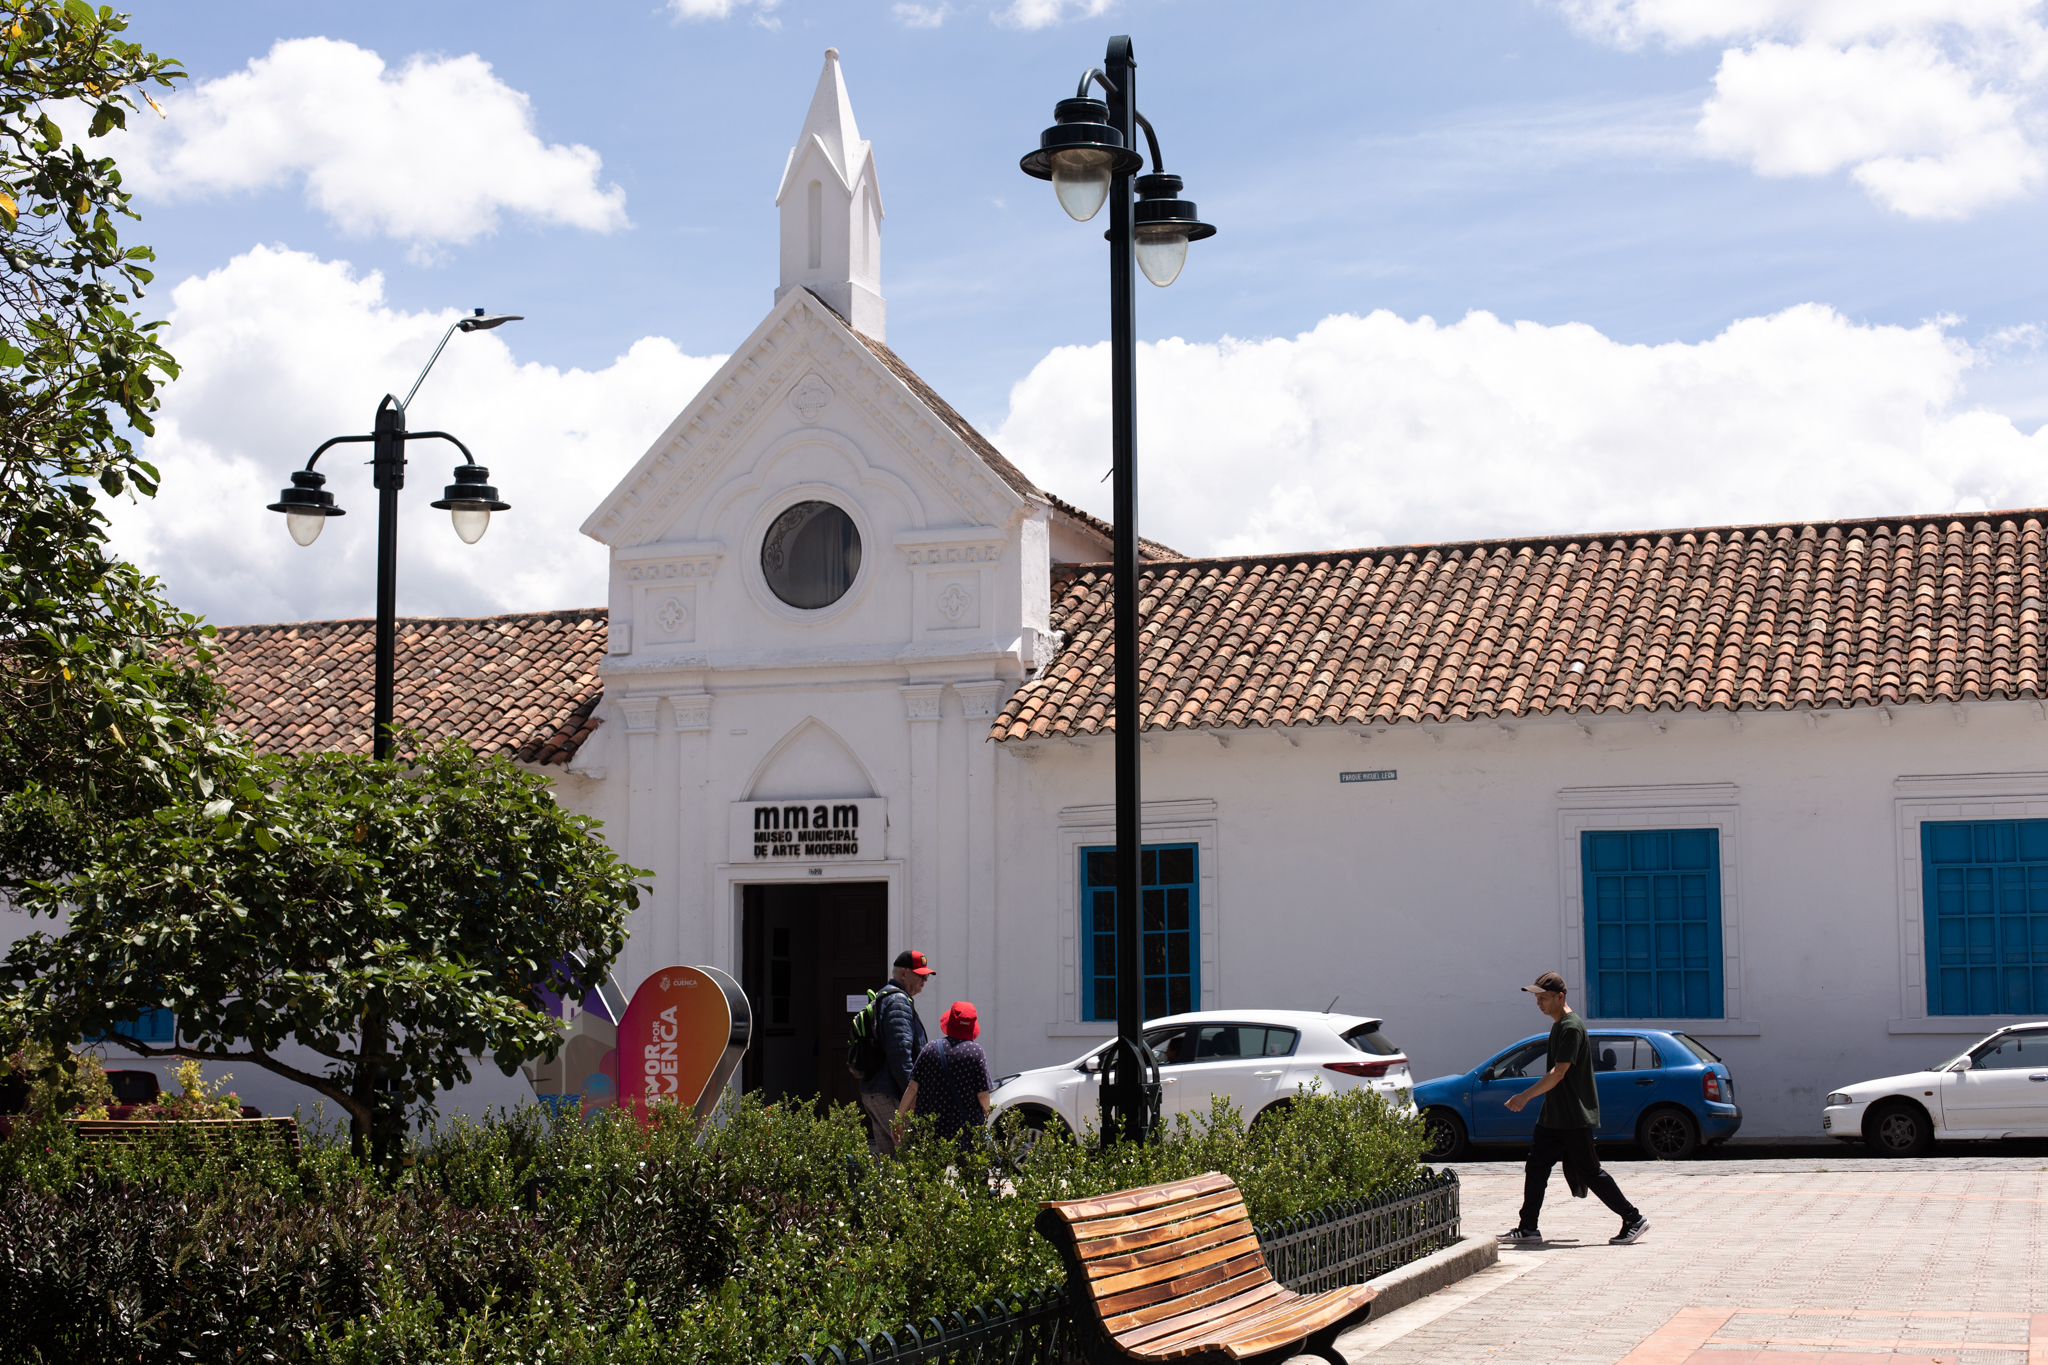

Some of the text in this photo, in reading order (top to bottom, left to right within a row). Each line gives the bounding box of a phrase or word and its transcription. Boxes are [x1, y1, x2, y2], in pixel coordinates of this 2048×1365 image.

[1342, 773, 1362, 781] PARQUE
[754, 804, 859, 830] mmam
[754, 829, 859, 843] MUSEO MUNICIPAL
[754, 843, 858, 856] DE ARTE MODERNO
[652, 1021, 660, 1042] POR
[660, 1005, 678, 1107] UENCA
